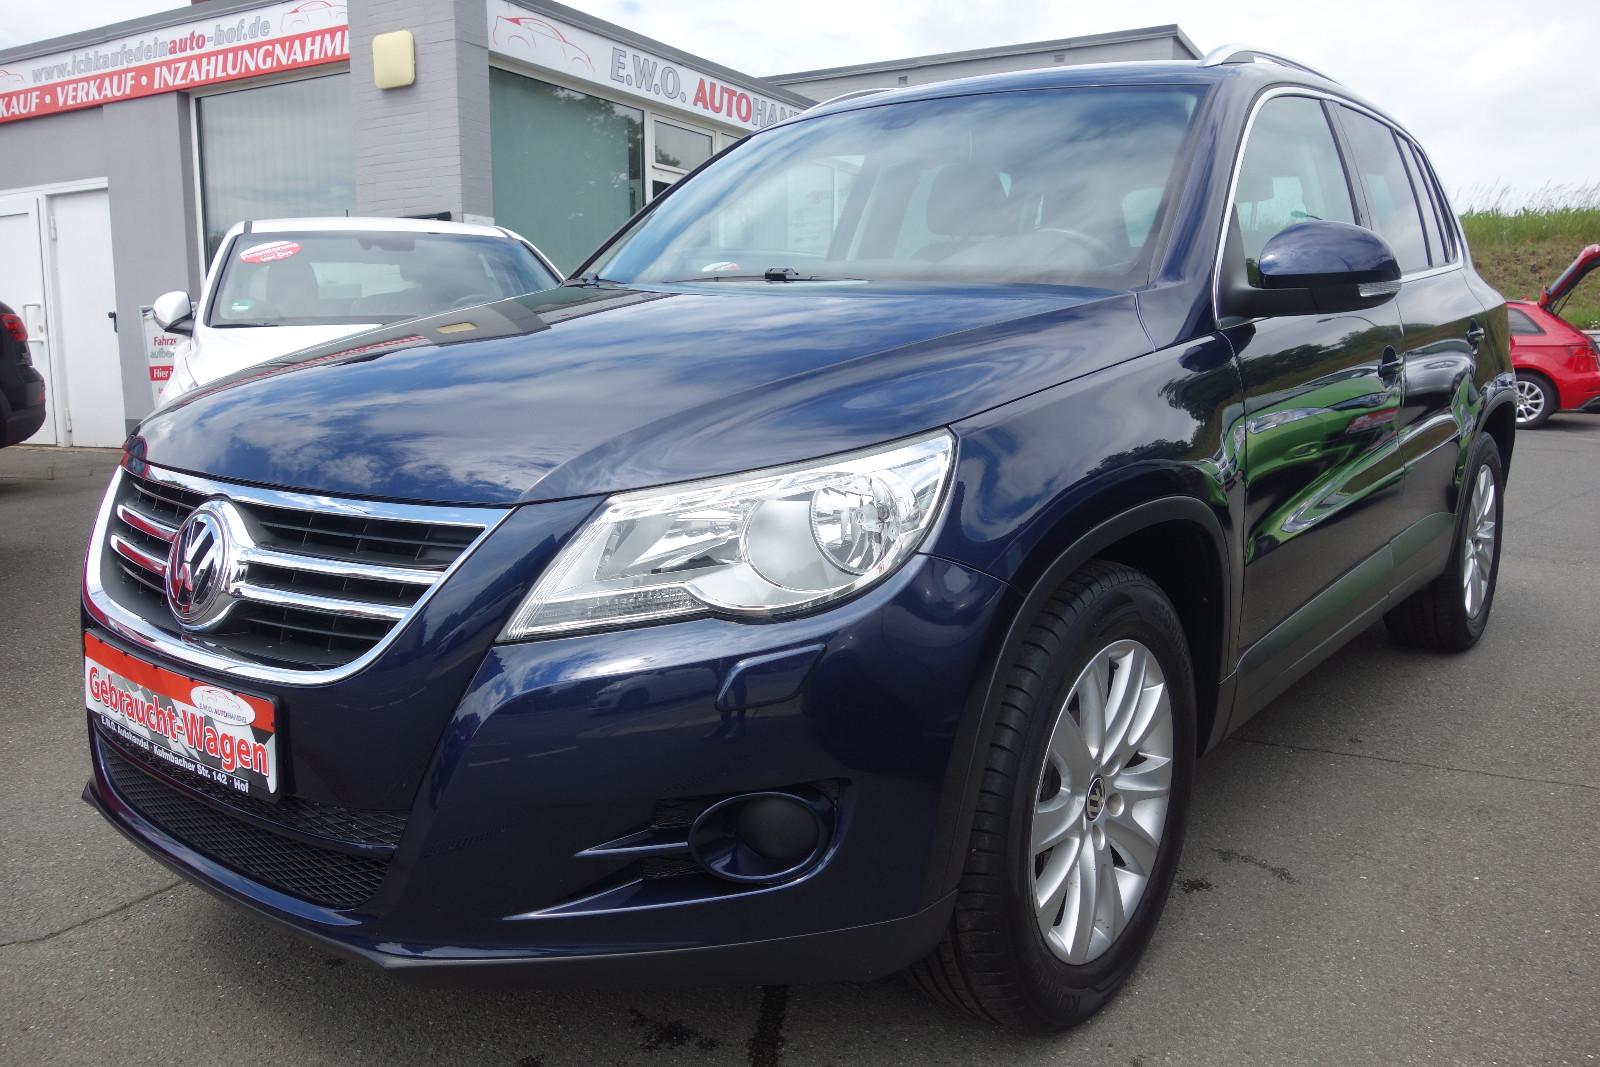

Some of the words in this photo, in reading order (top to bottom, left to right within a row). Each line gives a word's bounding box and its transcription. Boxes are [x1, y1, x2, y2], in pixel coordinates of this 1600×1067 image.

[32, 15, 270, 84] www.ichkaufedeinauto-hof.de
[610, 47, 687, 103] E.W.O.
[56, 71, 136, 107] VERKAUF
[153, 367, 169, 379] Hier
[89, 666, 270, 776] Gebraucht-Wagen
[117, 727, 150, 751] Autohandel
[153, 744, 196, 772] Kulmbacher
[196, 763, 211, 779] Str.
[212, 770, 228, 785] 142
[233, 777, 249, 794] Hof
